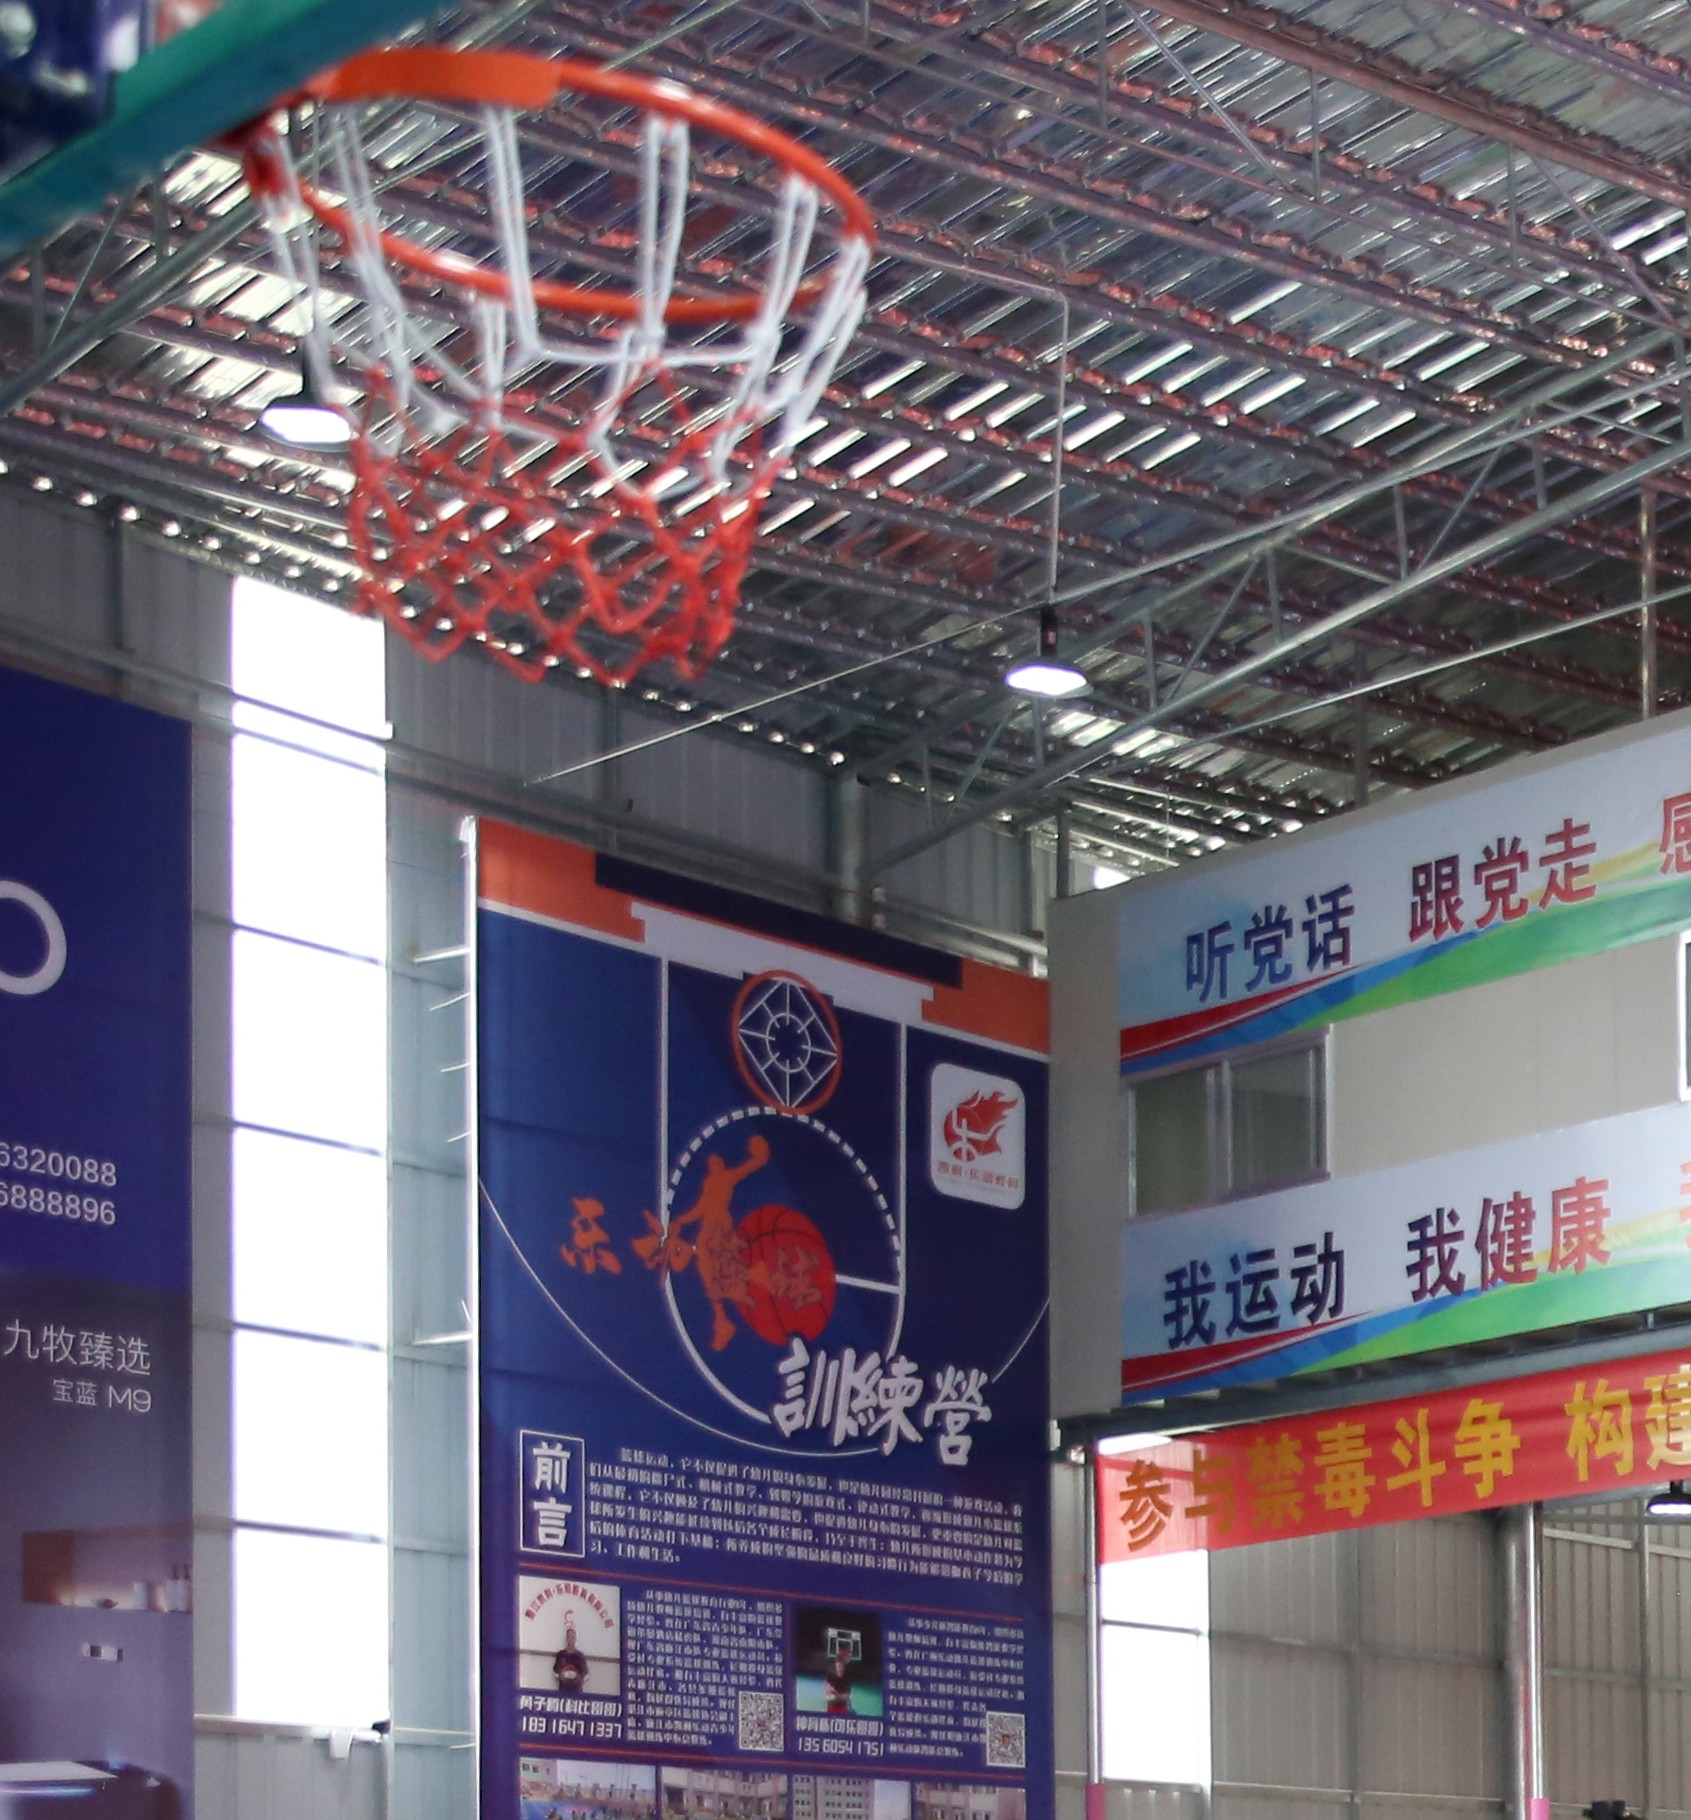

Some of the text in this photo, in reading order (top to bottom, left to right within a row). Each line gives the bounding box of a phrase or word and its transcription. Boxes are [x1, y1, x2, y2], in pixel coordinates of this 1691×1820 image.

[1184, 882, 1356, 1003] 听党话
[1408, 817, 1598, 944] 跟党走
[1163, 1231, 1347, 1350] 我运动
[1405, 1174, 1612, 1302] 我健康
[4, 1319, 151, 1376] 九牧臻选
[53, 1378, 152, 1412] 宝蓝 M9
[769, 1335, 993, 1466] 訓練營
[532, 1440, 573, 1548] 前言
[1118, 1399, 1522, 1553] 参与禁毒斗争
[522, 1716, 623, 1738] 183 1647 1337
[798, 1737, 820, 1753] 135
